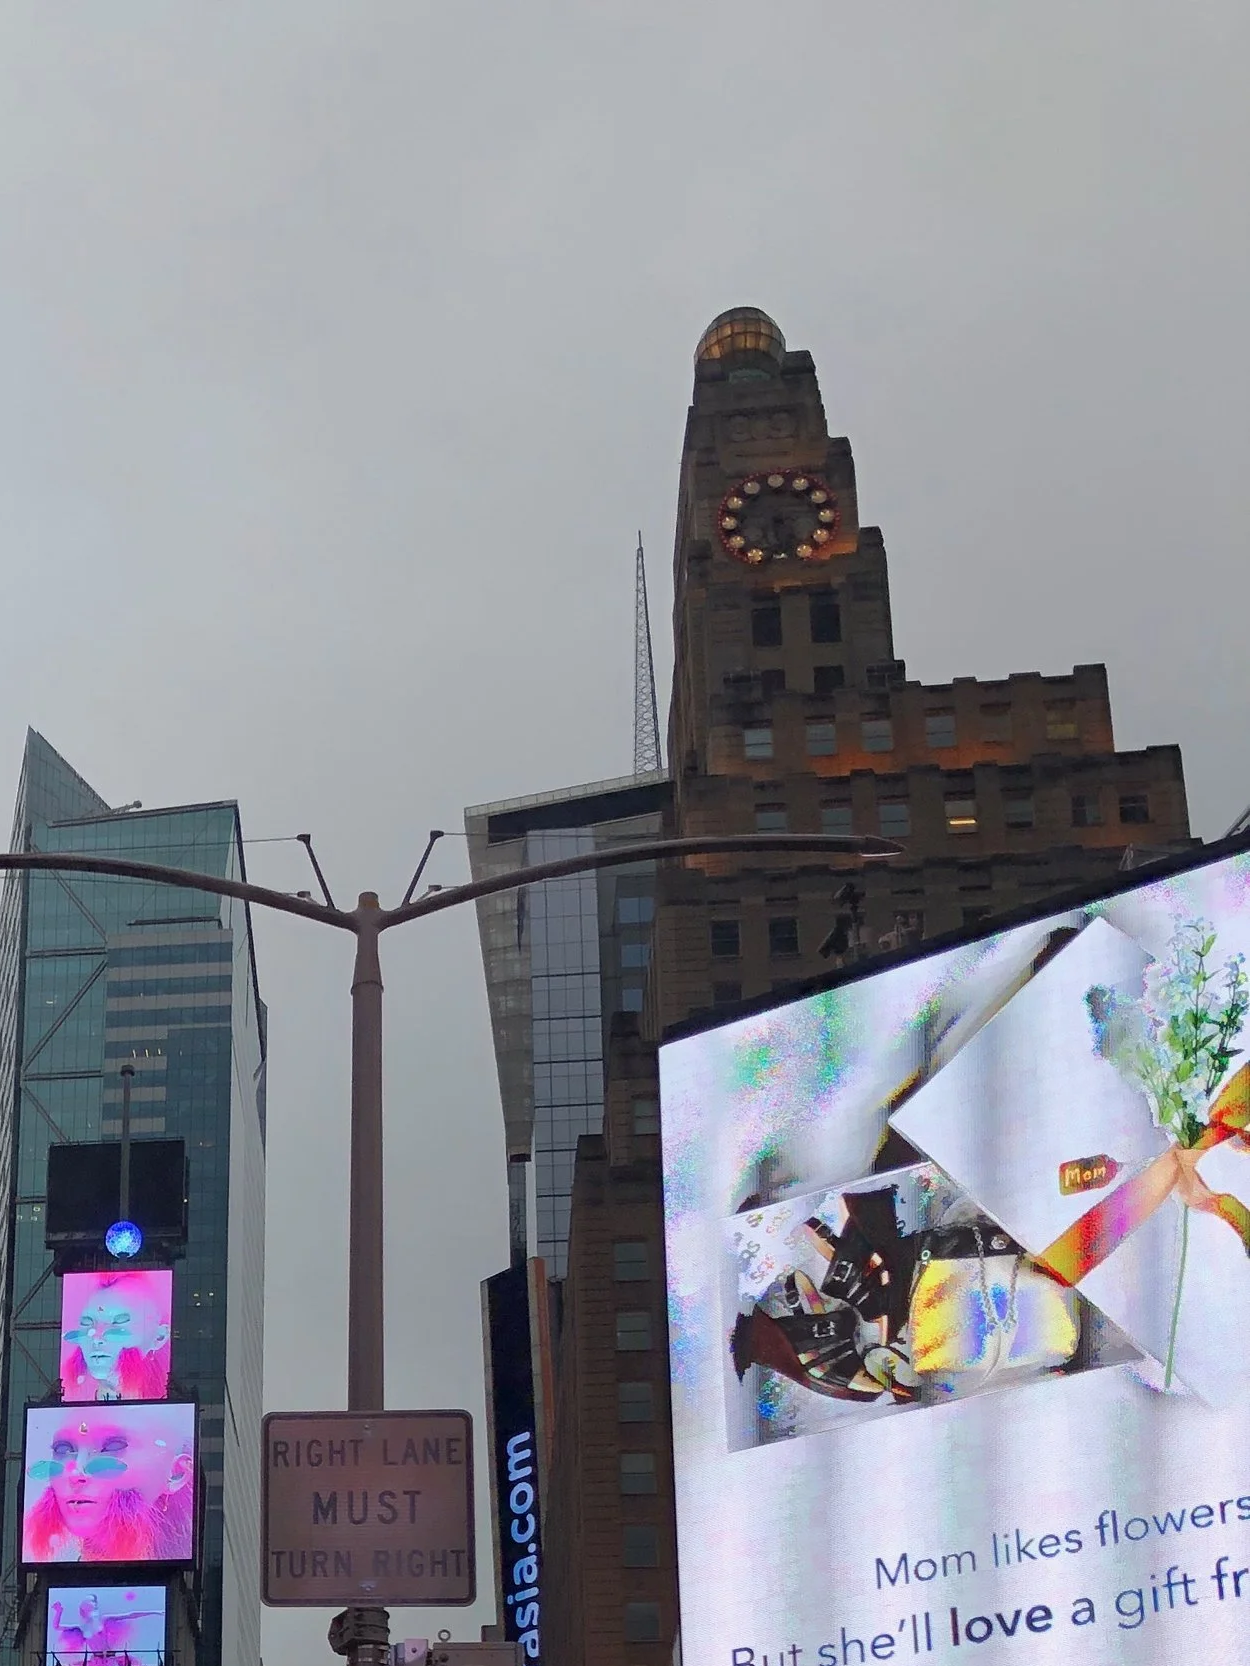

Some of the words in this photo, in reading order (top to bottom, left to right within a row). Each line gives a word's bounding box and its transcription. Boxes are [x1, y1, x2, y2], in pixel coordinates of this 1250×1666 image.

[272, 1438, 364, 1468] RIGHT
[381, 1437, 464, 1467] LANE
[312, 1489, 422, 1526] MUST
[270, 1550, 350, 1579] TURN
[371, 1549, 466, 1578] RIGHT
[873, 1550, 978, 1590] Mom
[991, 1525, 1083, 1569] likes
[949, 1600, 1054, 1646] love
[1070, 1596, 1097, 1628] a
[1115, 1567, 1198, 1630] gift
